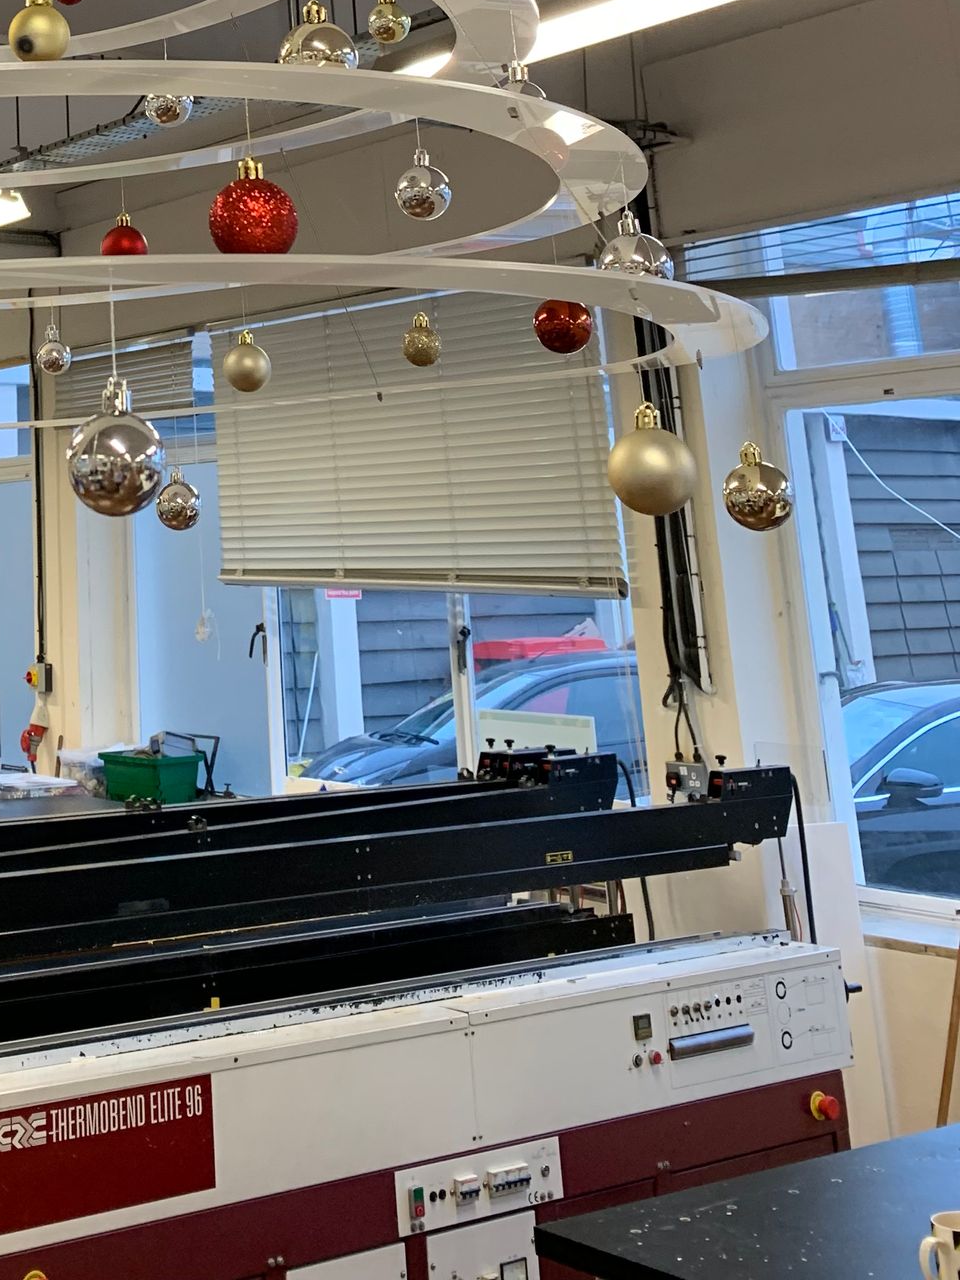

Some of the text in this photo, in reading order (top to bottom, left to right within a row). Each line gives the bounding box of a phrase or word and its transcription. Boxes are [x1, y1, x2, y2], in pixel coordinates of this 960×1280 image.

[48, 1094, 145, 1143] THERMOBEND
[149, 1087, 182, 1124] ELITE
[185, 1084, 203, 1118] 96
